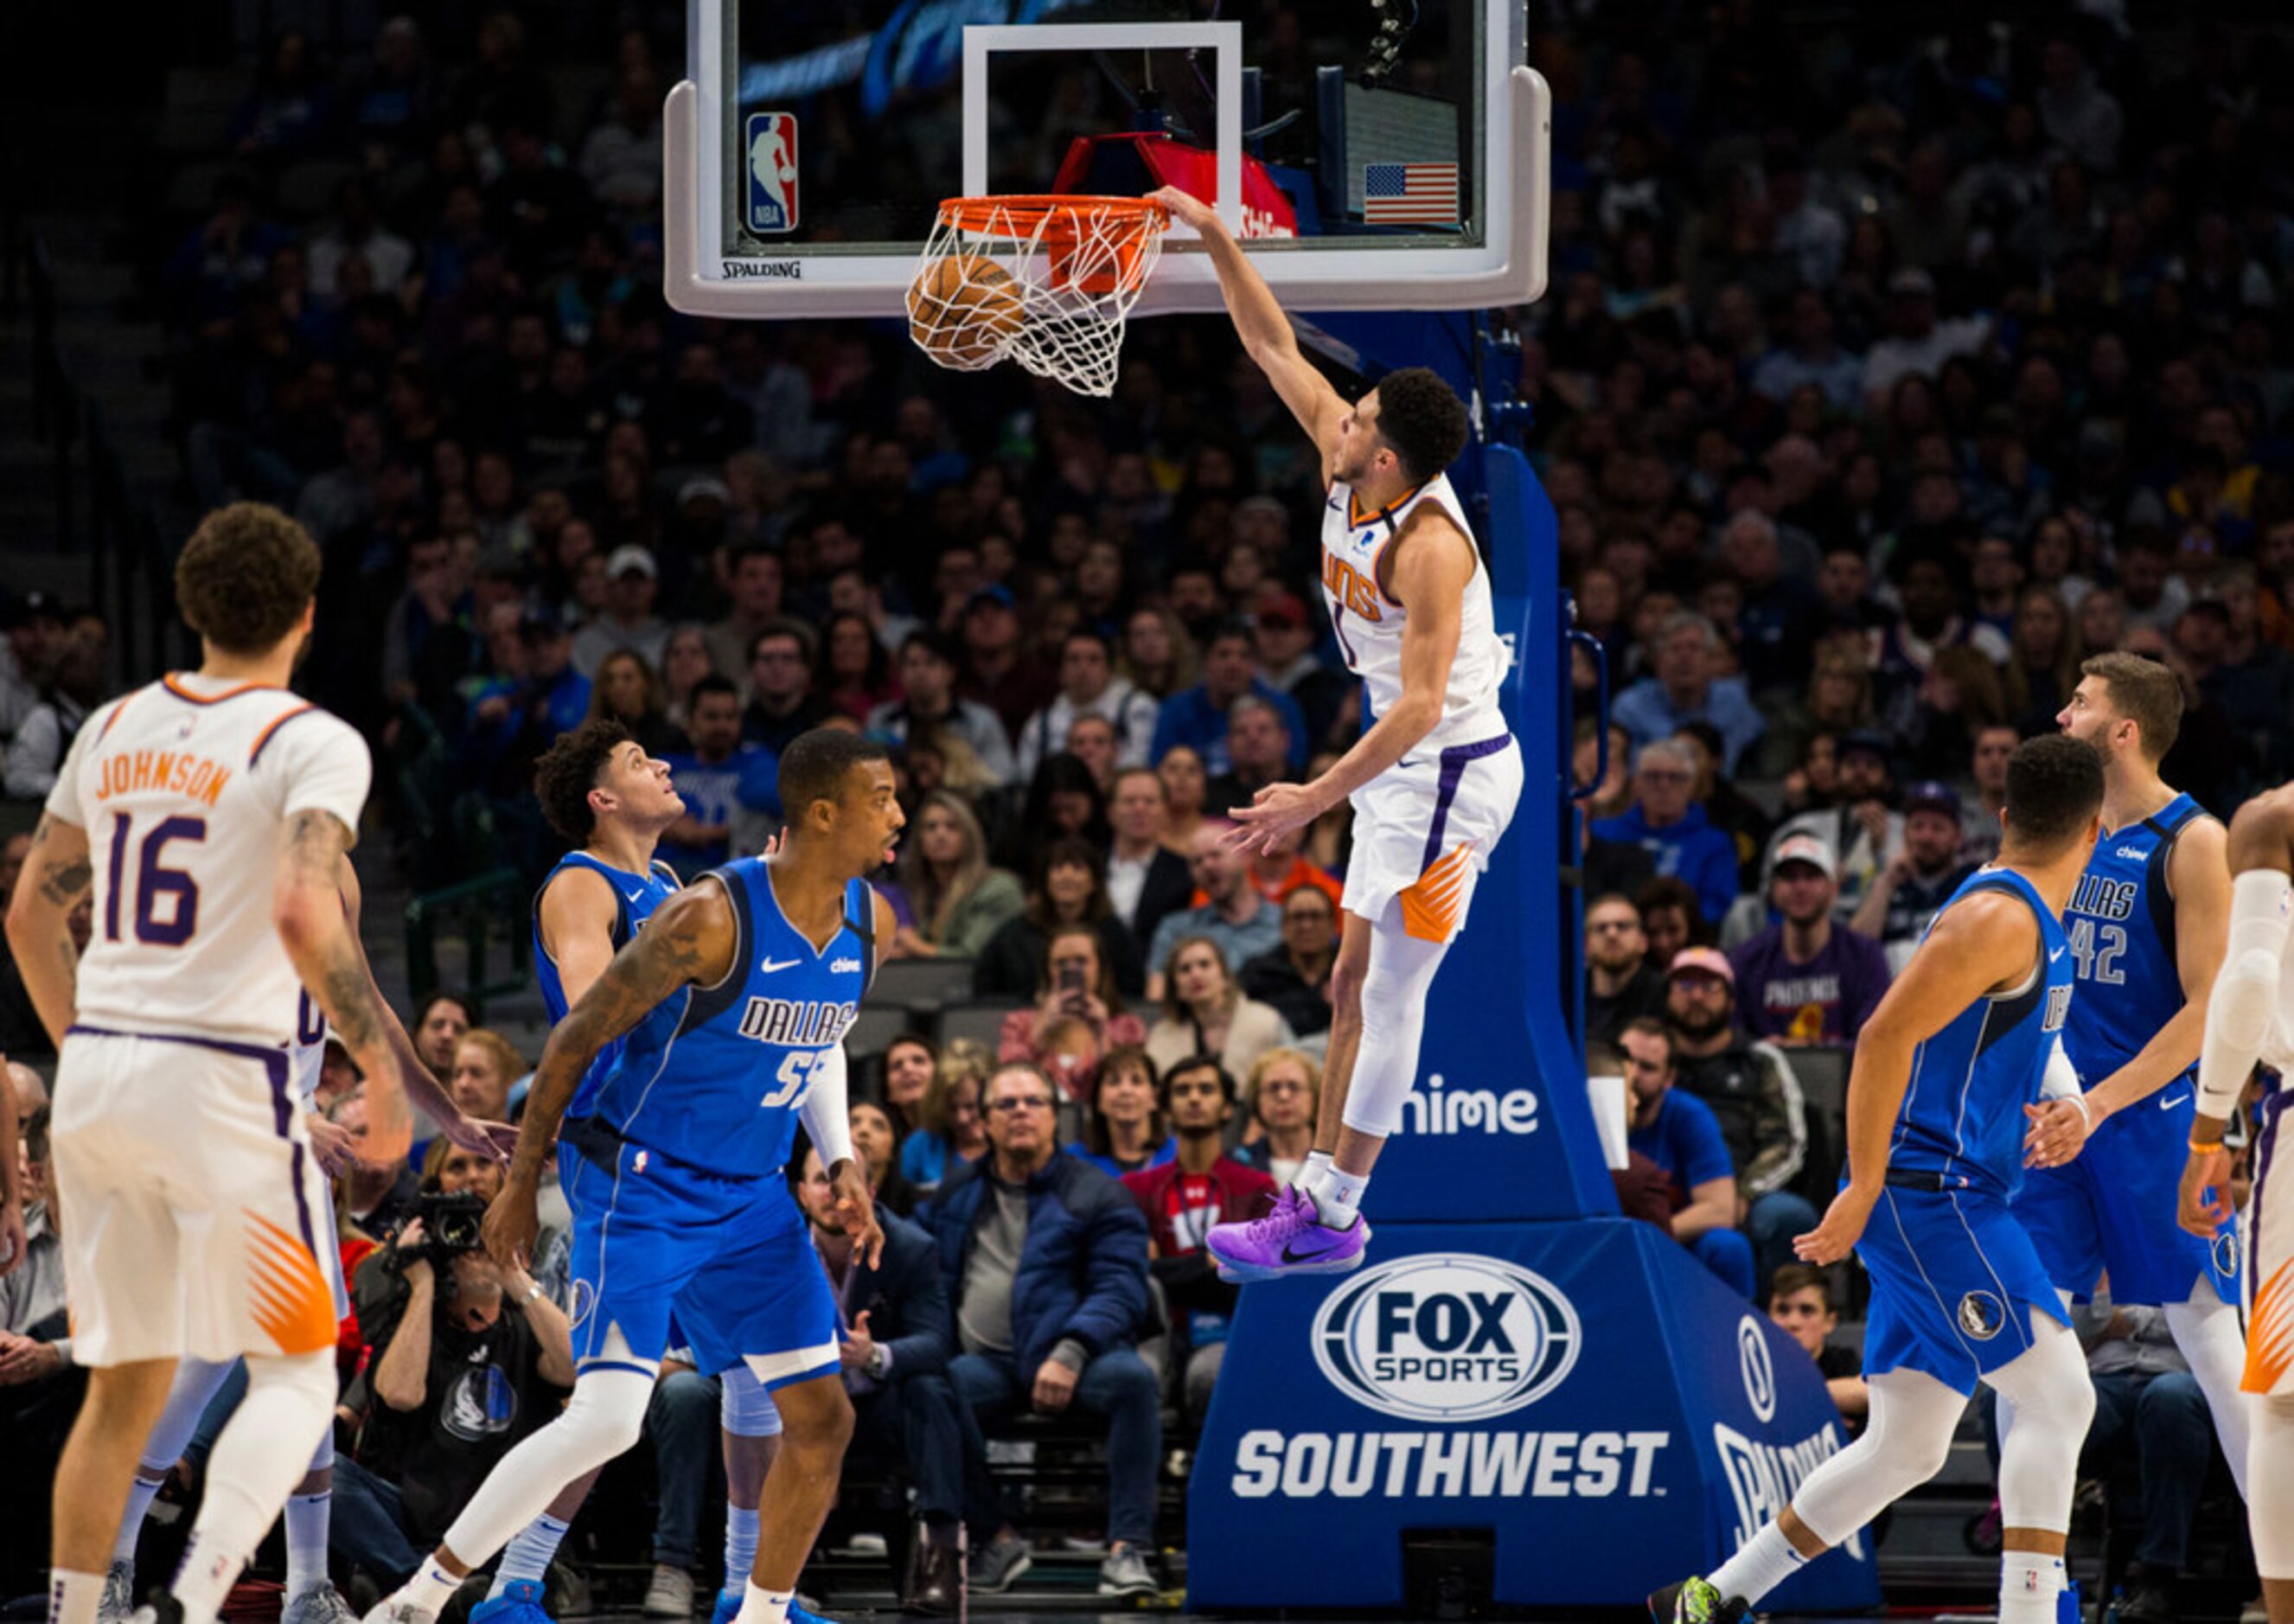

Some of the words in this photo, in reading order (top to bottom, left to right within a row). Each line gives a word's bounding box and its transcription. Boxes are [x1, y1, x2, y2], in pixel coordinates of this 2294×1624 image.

[754, 205, 780, 225] NBA
[722, 261, 802, 278] SPALDING
[96, 748, 233, 808] JOHNSON
[105, 809, 208, 948] 16
[2065, 872, 2138, 922] LLAS
[2070, 917, 2127, 985] 42
[1377, 1292, 1516, 1354] FOX
[1374, 1358, 1519, 1382] SPORTS
[1231, 1429, 1669, 1498] SOUTHWEST
